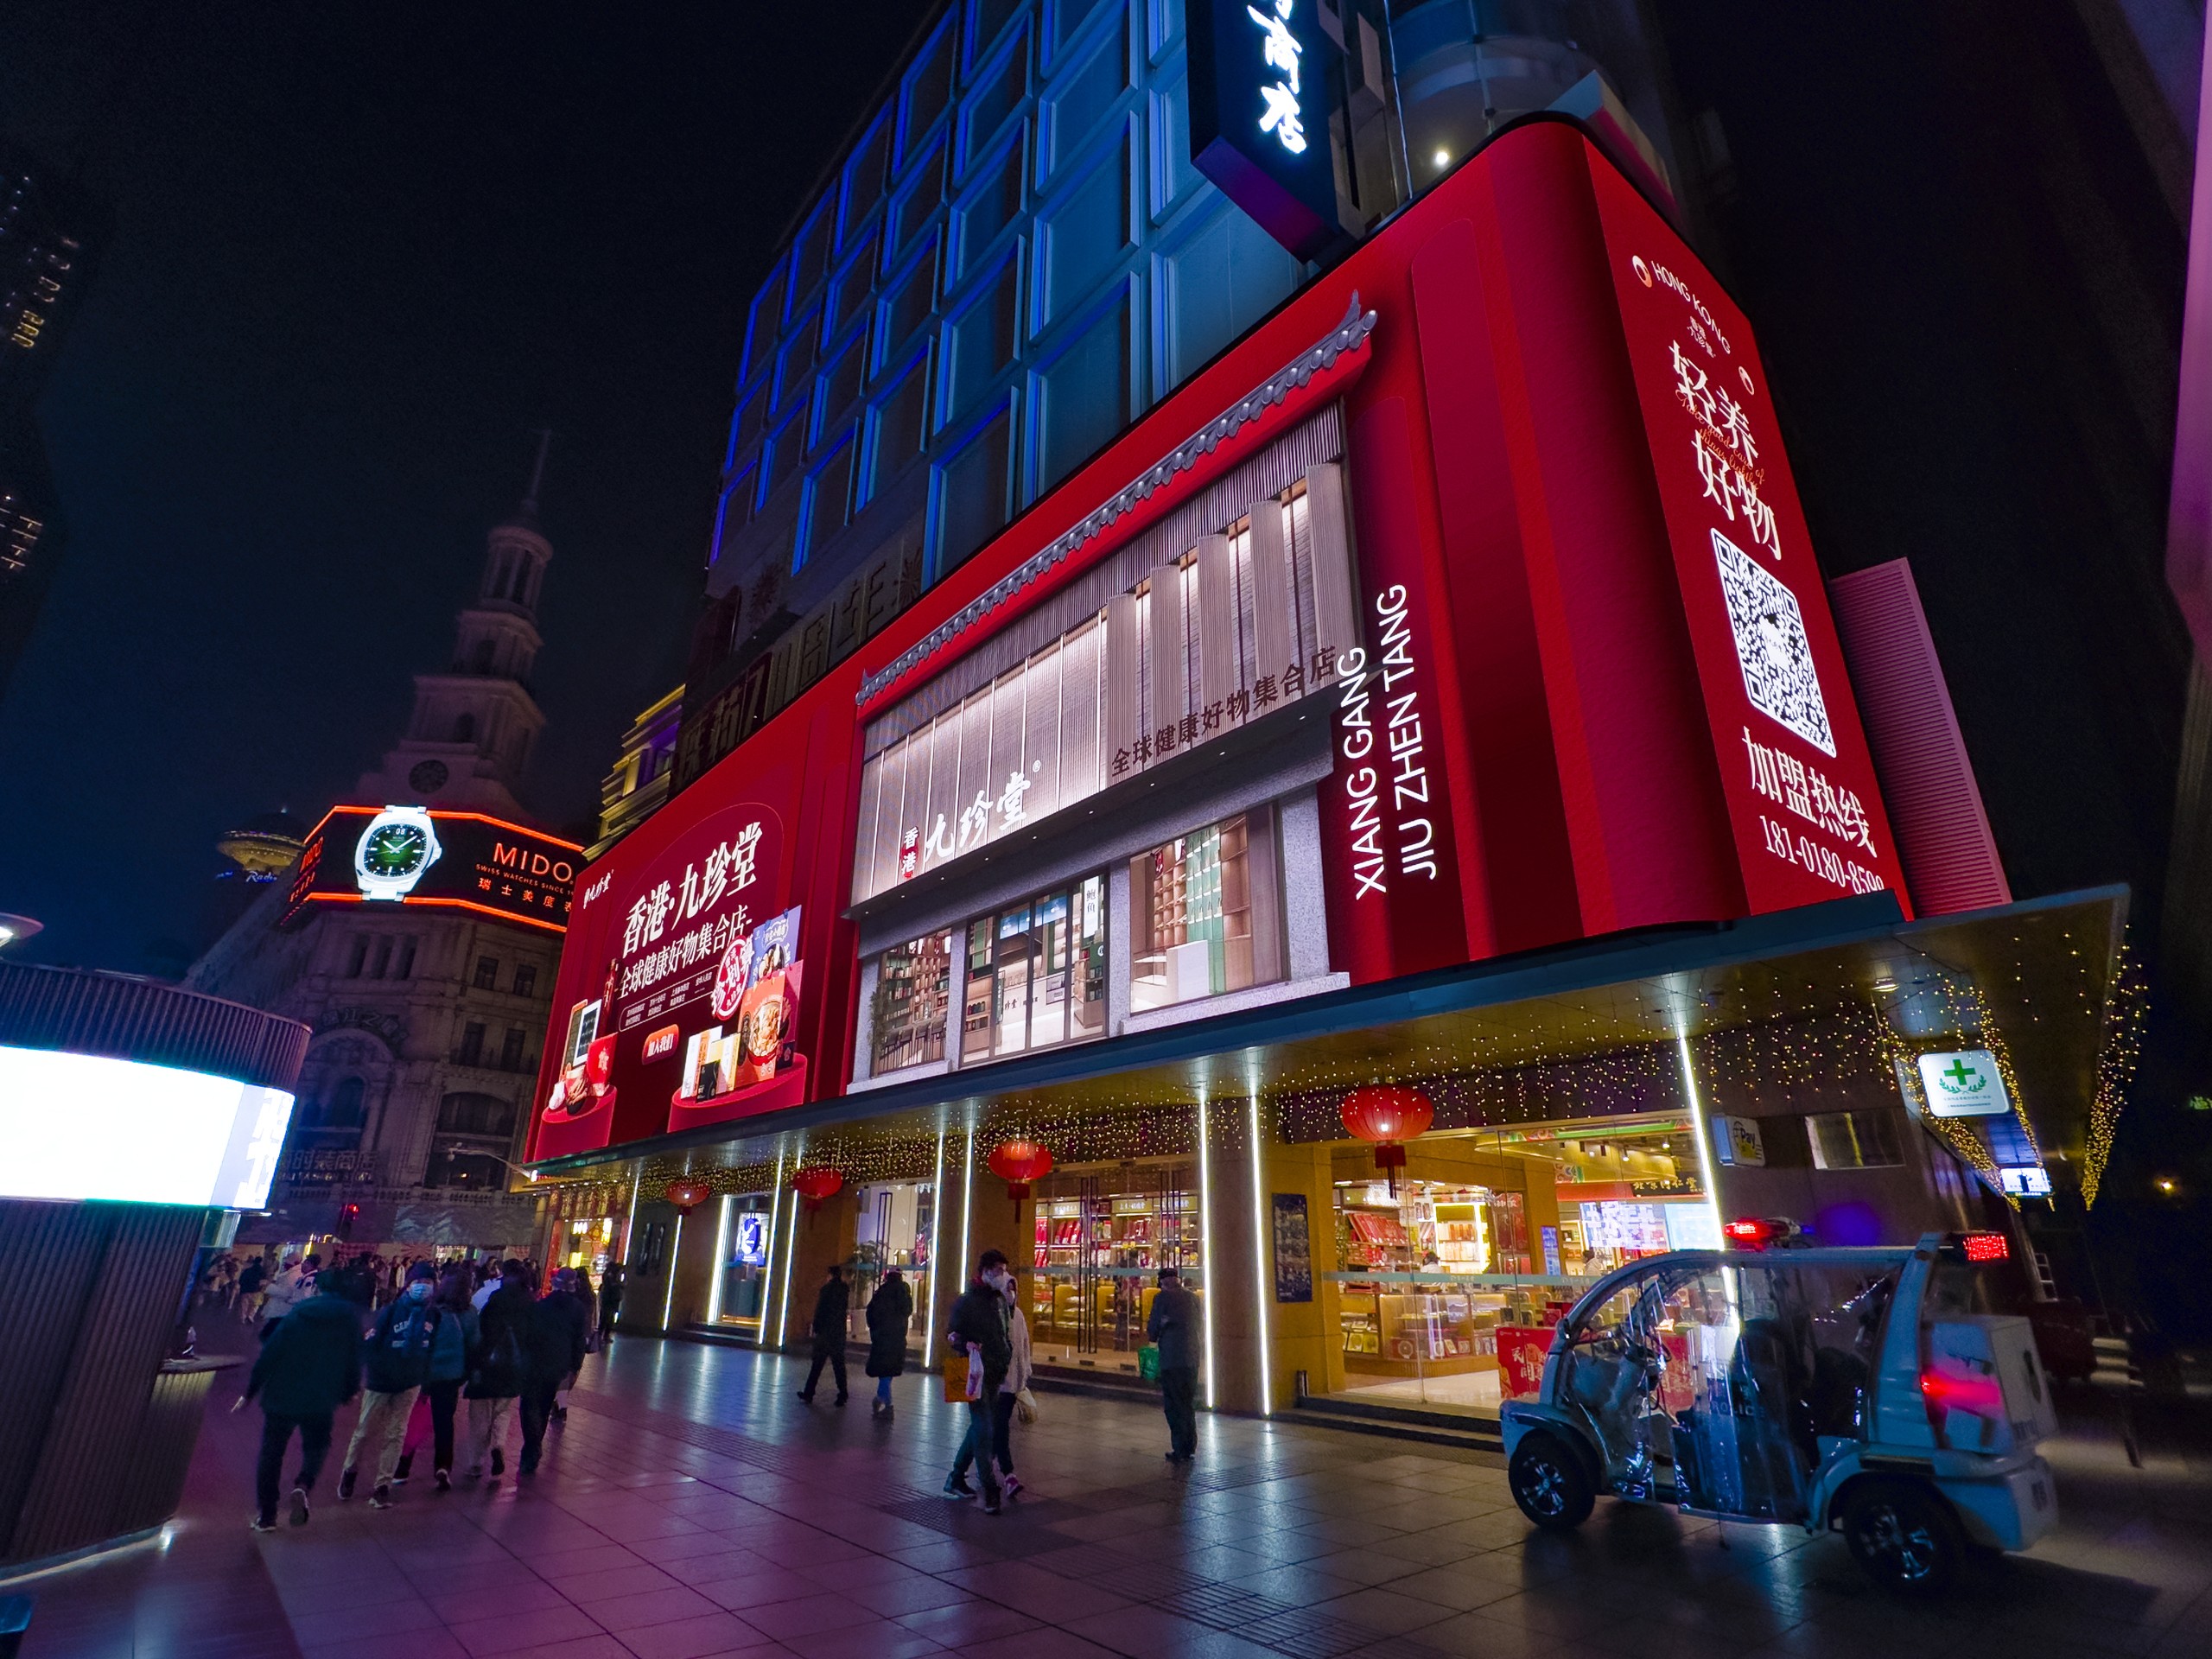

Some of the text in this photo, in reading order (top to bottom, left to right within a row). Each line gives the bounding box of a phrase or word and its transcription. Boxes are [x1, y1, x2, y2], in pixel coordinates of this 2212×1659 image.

[1651, 260, 1732, 355] HONG KONG
[1691, 429, 1783, 562] 好物
[1110, 645, 1337, 778] 全球健康好物集合店
[1376, 582, 1438, 881] JIU ZHEN TANG
[924, 770, 1033, 863] 九珍堂
[1337, 645, 1388, 901] XIANG GANG
[1741, 725, 1878, 859] 加盟热线
[475, 863, 500, 875] SWISS
[502, 871, 538, 887] WATCHES
[540, 881, 564, 894] SINCE
[493, 842, 573, 883] MIDO
[901, 826, 919, 874] 香港
[1740, 1127, 1756, 1148] Pay
